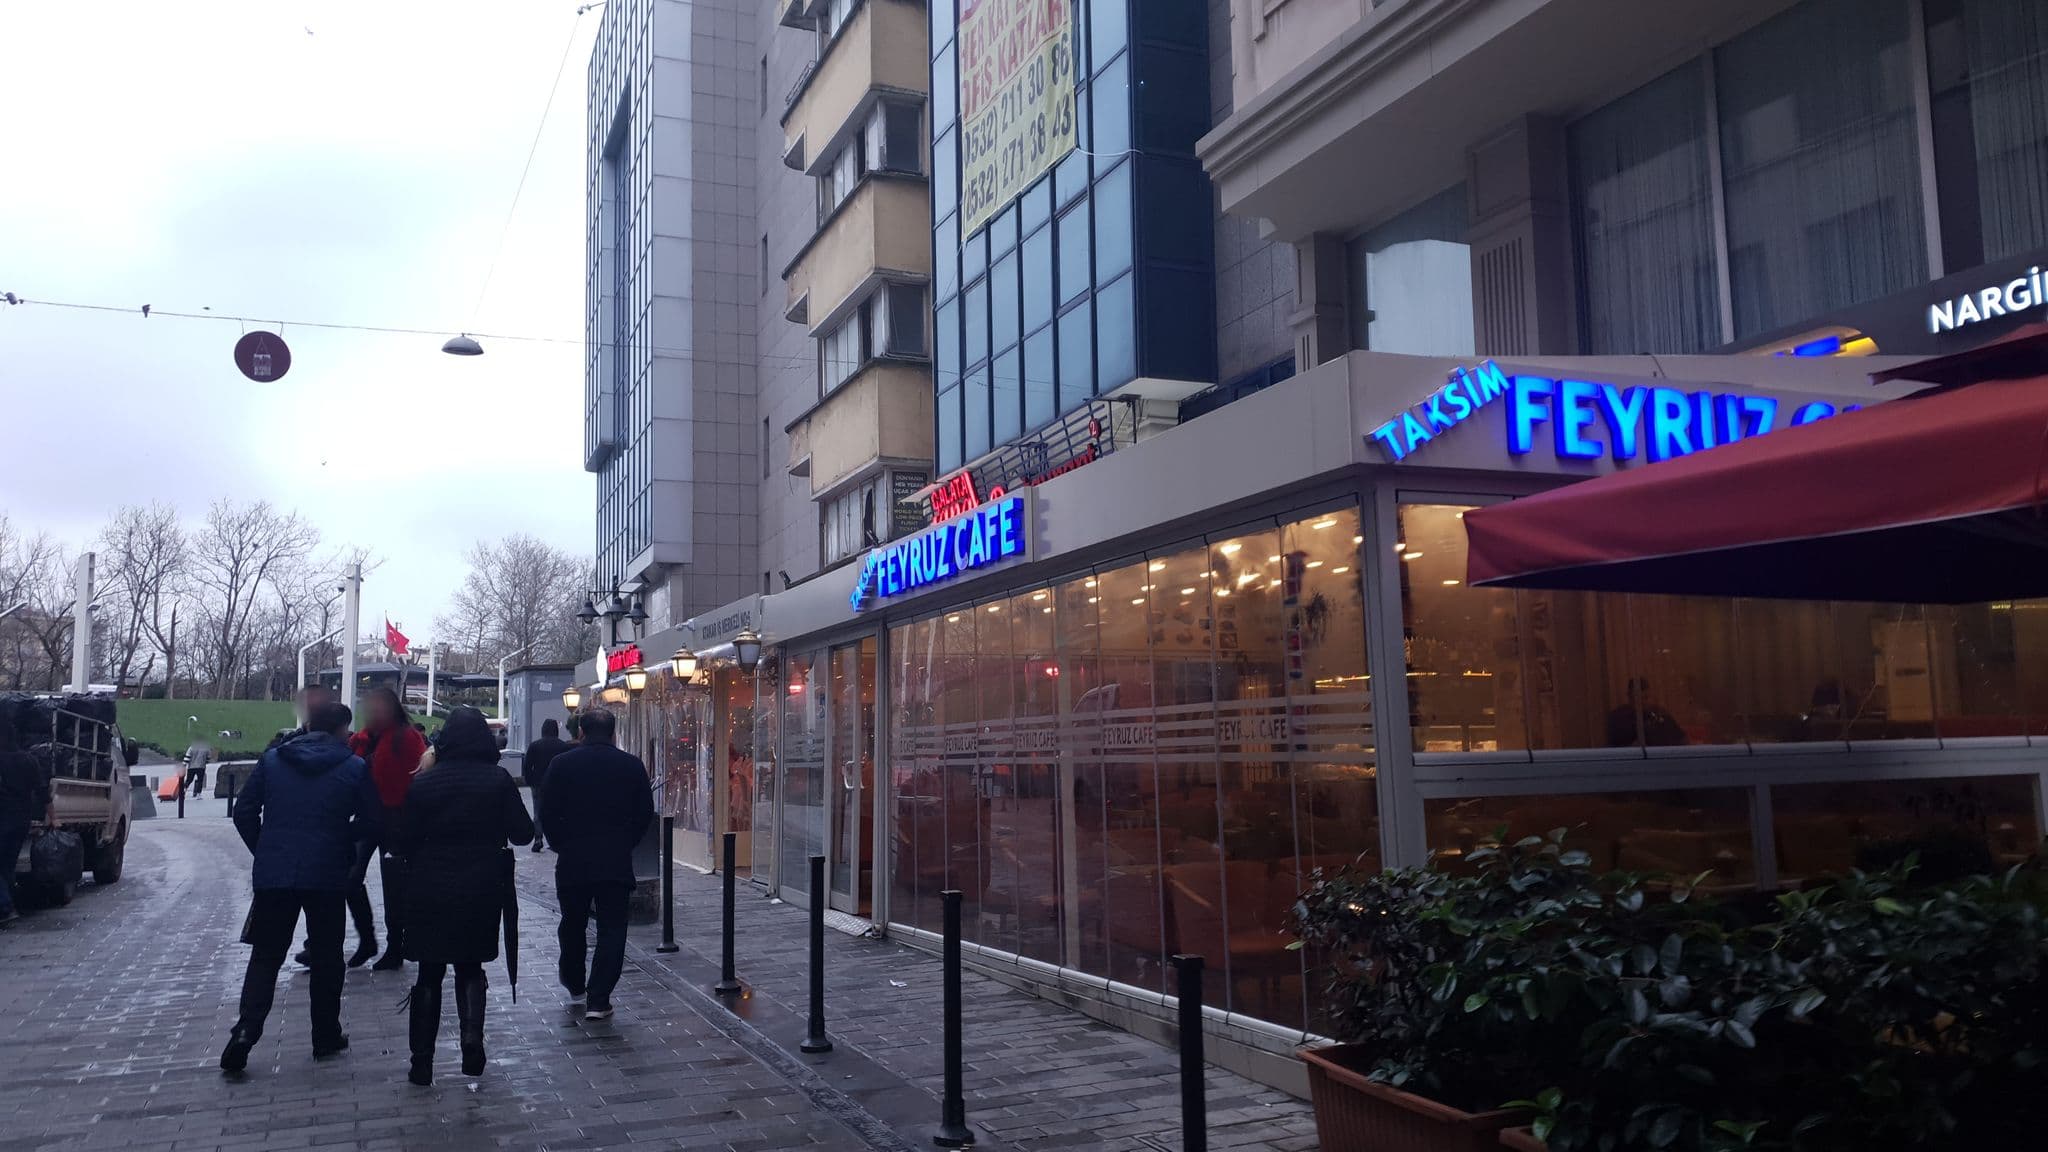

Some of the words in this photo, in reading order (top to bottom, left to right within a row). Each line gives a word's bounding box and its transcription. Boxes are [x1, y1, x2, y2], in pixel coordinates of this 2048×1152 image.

[1001, 74, 1023, 134] 211
[1028, 54, 1045, 106] 30
[1051, 32, 1071, 86] 86
[1002, 131, 1024, 189] 271
[1029, 112, 1047, 162] 38
[1052, 92, 1072, 138] 43
[1930, 265, 2048, 334] NARGİ
[1373, 360, 1511, 462] TAKSİM
[877, 526, 949, 597] FEYRUZ
[954, 498, 1016, 571] CAFE
[1102, 726, 1132, 745] FEYRUZ
[1133, 726, 1154, 743] CAFE
